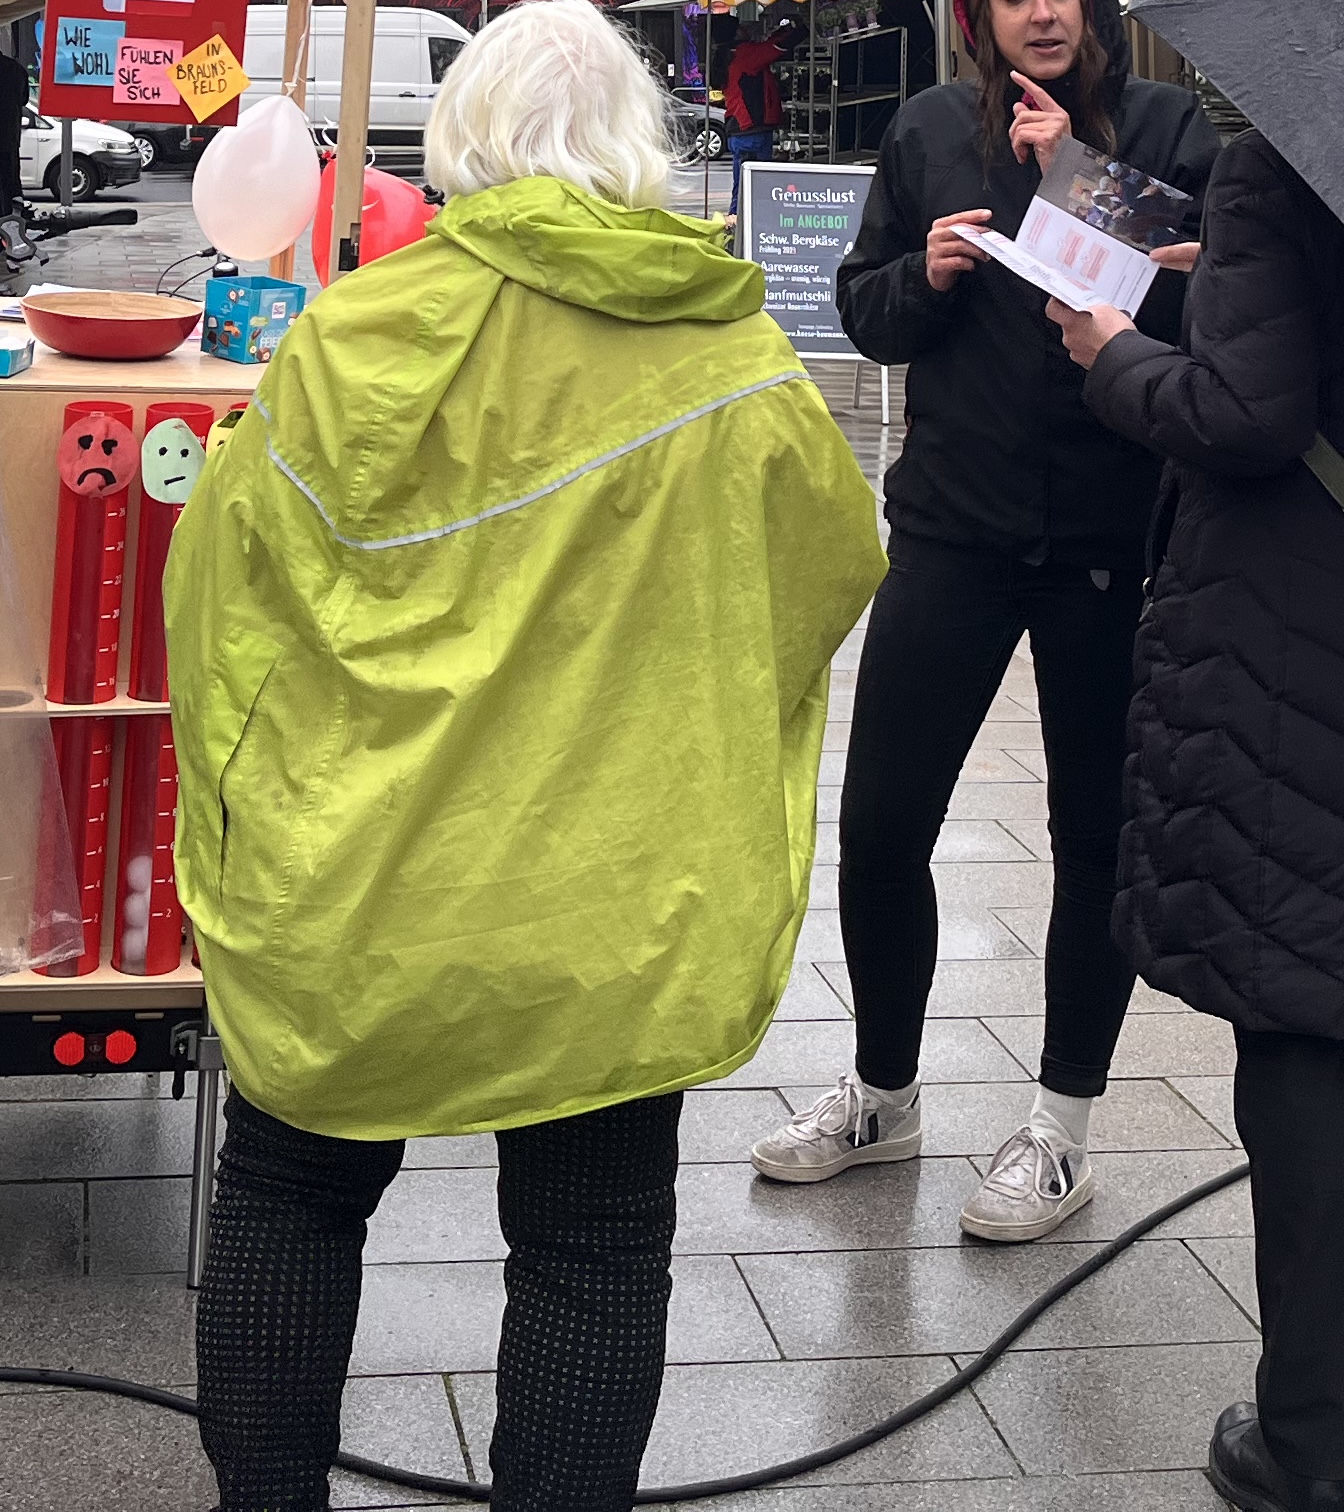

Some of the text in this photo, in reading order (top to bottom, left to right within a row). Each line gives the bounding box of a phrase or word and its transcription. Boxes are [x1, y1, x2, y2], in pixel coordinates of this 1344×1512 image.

[63, 25, 92, 48] WIE
[205, 43, 222, 57] IN
[72, 51, 114, 77] WOHL
[118, 65, 142, 86] SIE
[127, 85, 161, 101] SICH
[193, 79, 228, 96] FELD
[771, 187, 856, 204] Genusslust
[779, 213, 849, 230] Im ANGEBOT
[759, 232, 840, 249] Schw. Bergkäse
[760, 260, 820, 274] Aarewasser
[165, 908, 172, 919] 2
